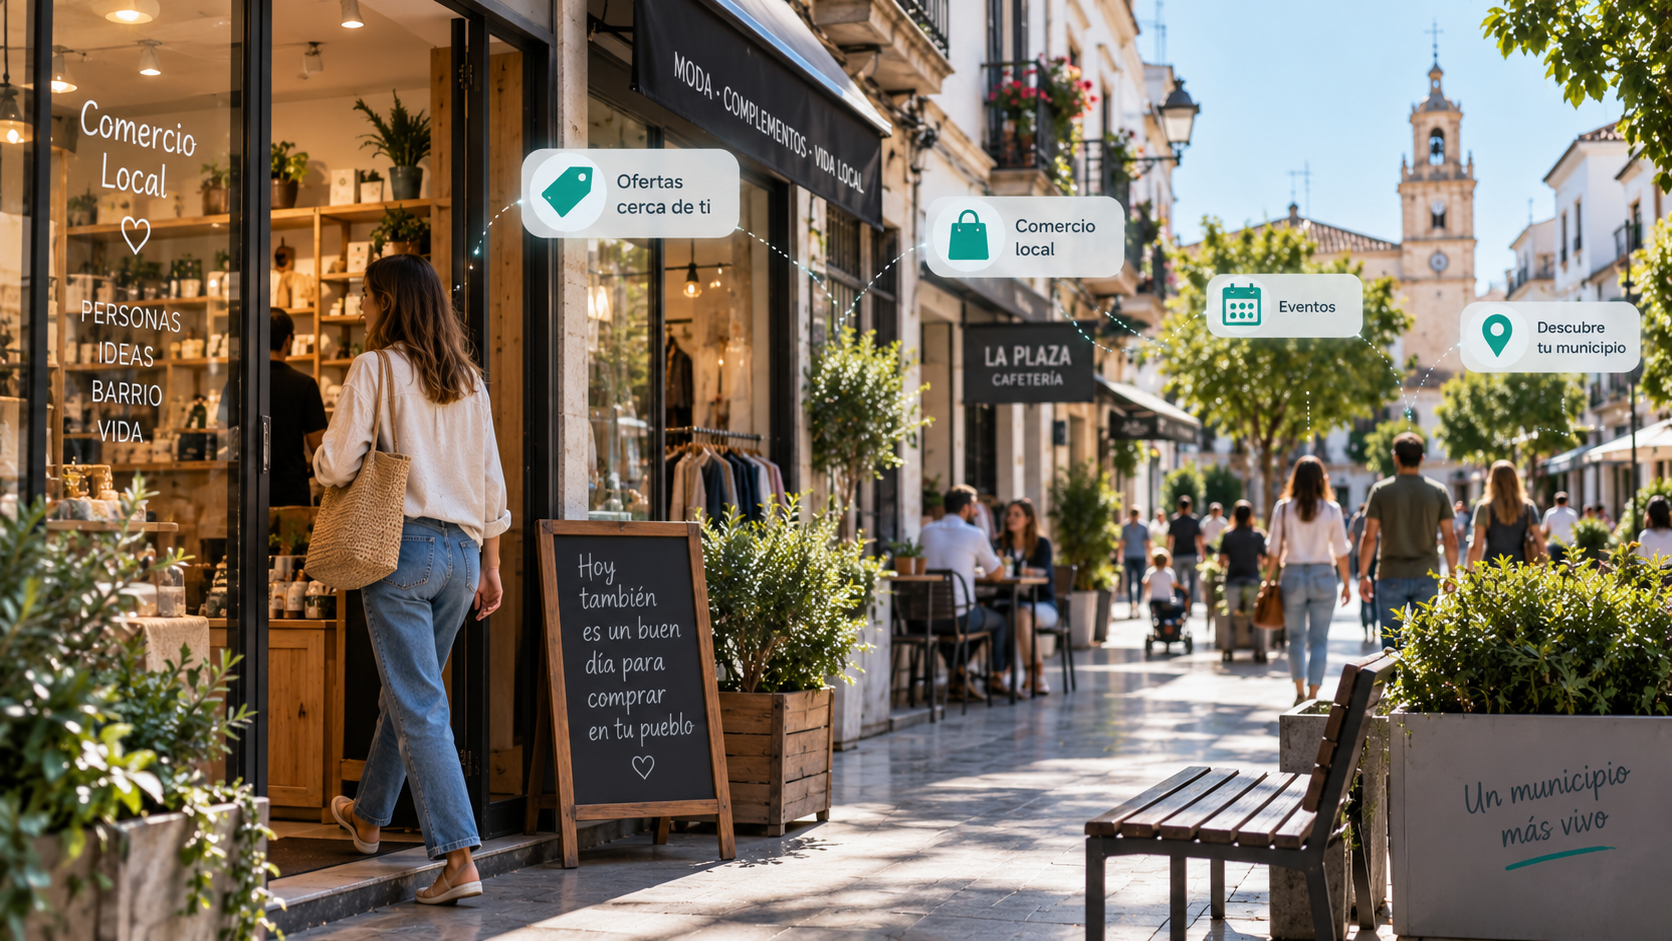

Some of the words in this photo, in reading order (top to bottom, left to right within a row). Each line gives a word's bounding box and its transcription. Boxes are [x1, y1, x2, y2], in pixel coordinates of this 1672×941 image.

[80, 99, 197, 157] Comercio
[674, 51, 713, 100] MODA
[723, 86, 807, 158] COMPLEMENTOS
[814, 144, 836, 177] VIDA
[837, 159, 865, 194] LOCAL
[101, 152, 167, 199] Local
[81, 299, 181, 333] PERSONAS
[98, 341, 154, 368] IDEAS
[984, 345, 1008, 367] LA
[1013, 345, 1072, 366] PLAZA
[92, 379, 163, 407] BARRIO
[992, 370, 1064, 386] CAFETERÍA
[97, 419, 144, 443] VIDA
[578, 552, 616, 586] Hoy
[579, 583, 658, 610] también
[583, 624, 601, 642] es
[608, 624, 632, 641] un
[638, 615, 682, 640] buen
[585, 650, 616, 675] día
[622, 656, 666, 682] para
[587, 688, 666, 715] comprar
[588, 724, 609, 742] en
[613, 717, 634, 740] tu
[640, 711, 695, 747] pueblo
[1464, 781, 1503, 815] Un
[1511, 761, 1631, 804] municipio
[1501, 815, 1553, 848] más
[1560, 808, 1609, 836] vivo
